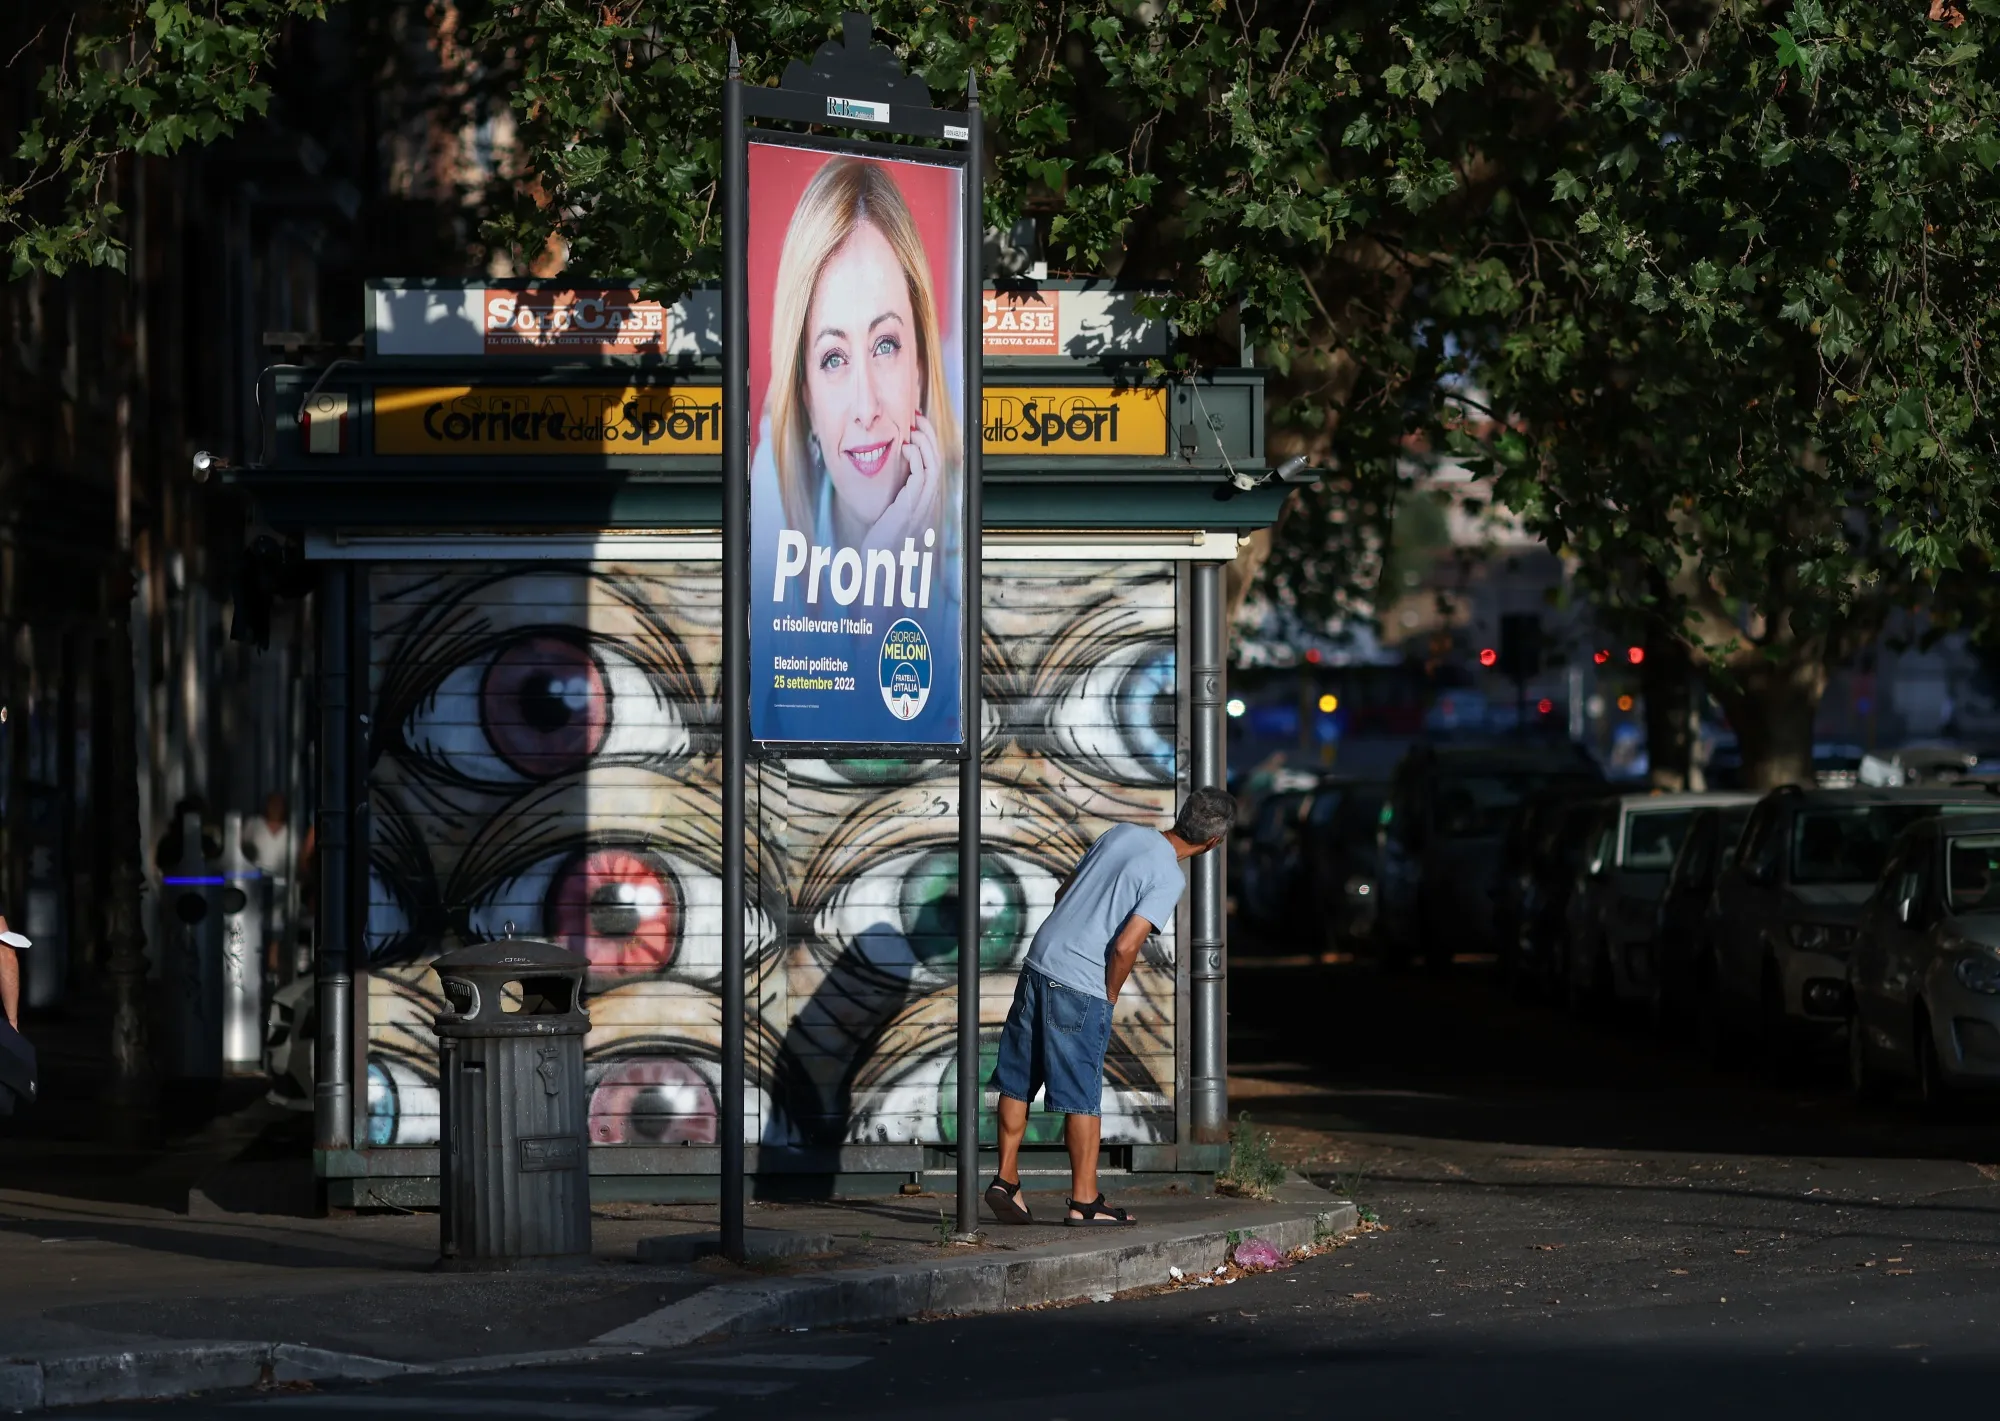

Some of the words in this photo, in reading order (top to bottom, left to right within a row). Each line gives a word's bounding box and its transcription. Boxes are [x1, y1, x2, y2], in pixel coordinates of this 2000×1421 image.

[487, 337, 499, 345] IL
[558, 337, 580, 345] CHE
[988, 338, 1023, 346] TROVA
[424, 401, 566, 441] Corriere
[568, 416, 619, 441] dello
[622, 401, 721, 446] Sport
[984, 417, 1018, 442] ello
[1021, 402, 1120, 447] Sport
[773, 527, 936, 609] Pronti
[773, 618, 781, 631] a
[782, 615, 839, 633] risollevare
[840, 618, 873, 635] l'Italia
[890, 631, 922, 643] GIORGIA
[885, 643, 927, 660] MELONI
[774, 656, 808, 670] Elezioni
[809, 656, 848, 675] politiche
[774, 674, 785, 688] 25
[786, 676, 833, 690] settembre
[834, 677, 855, 691] 2022
[895, 674, 917, 682] FRATELLI
